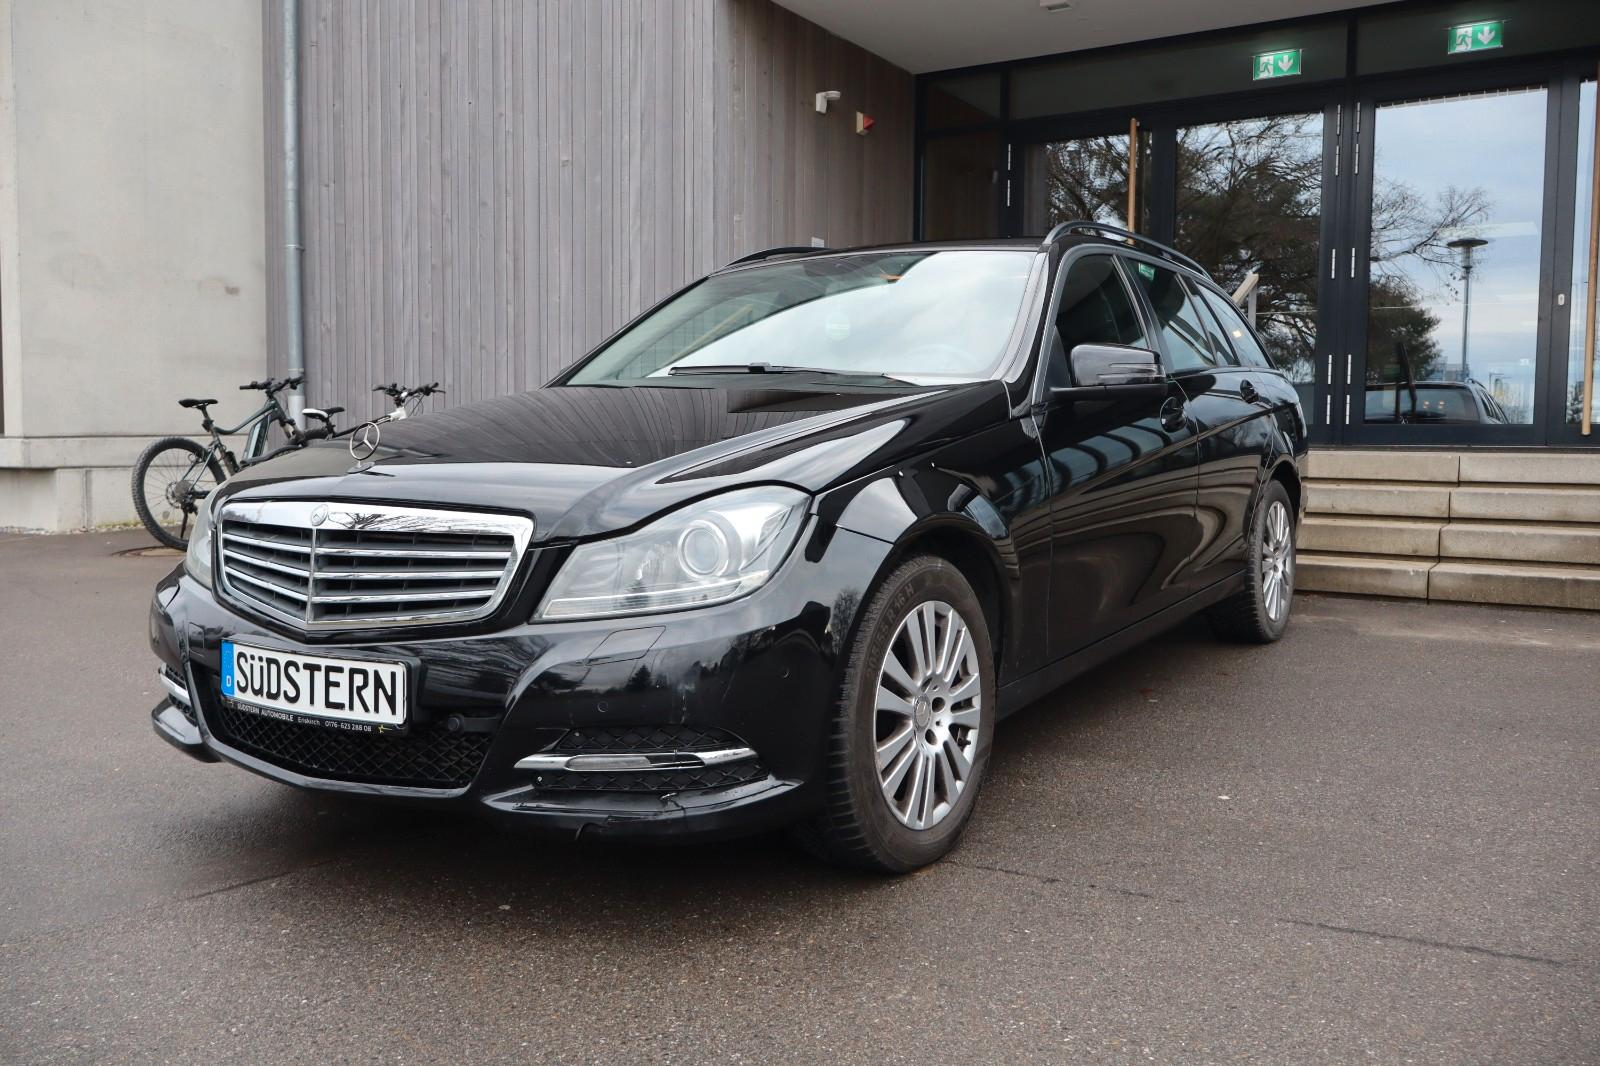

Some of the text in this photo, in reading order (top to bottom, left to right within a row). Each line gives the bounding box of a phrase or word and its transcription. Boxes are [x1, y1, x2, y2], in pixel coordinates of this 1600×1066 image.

[226, 674, 232, 688] D
[236, 651, 397, 716] SÜDSTERN
[261, 709, 294, 722] AUTOMOBILE
